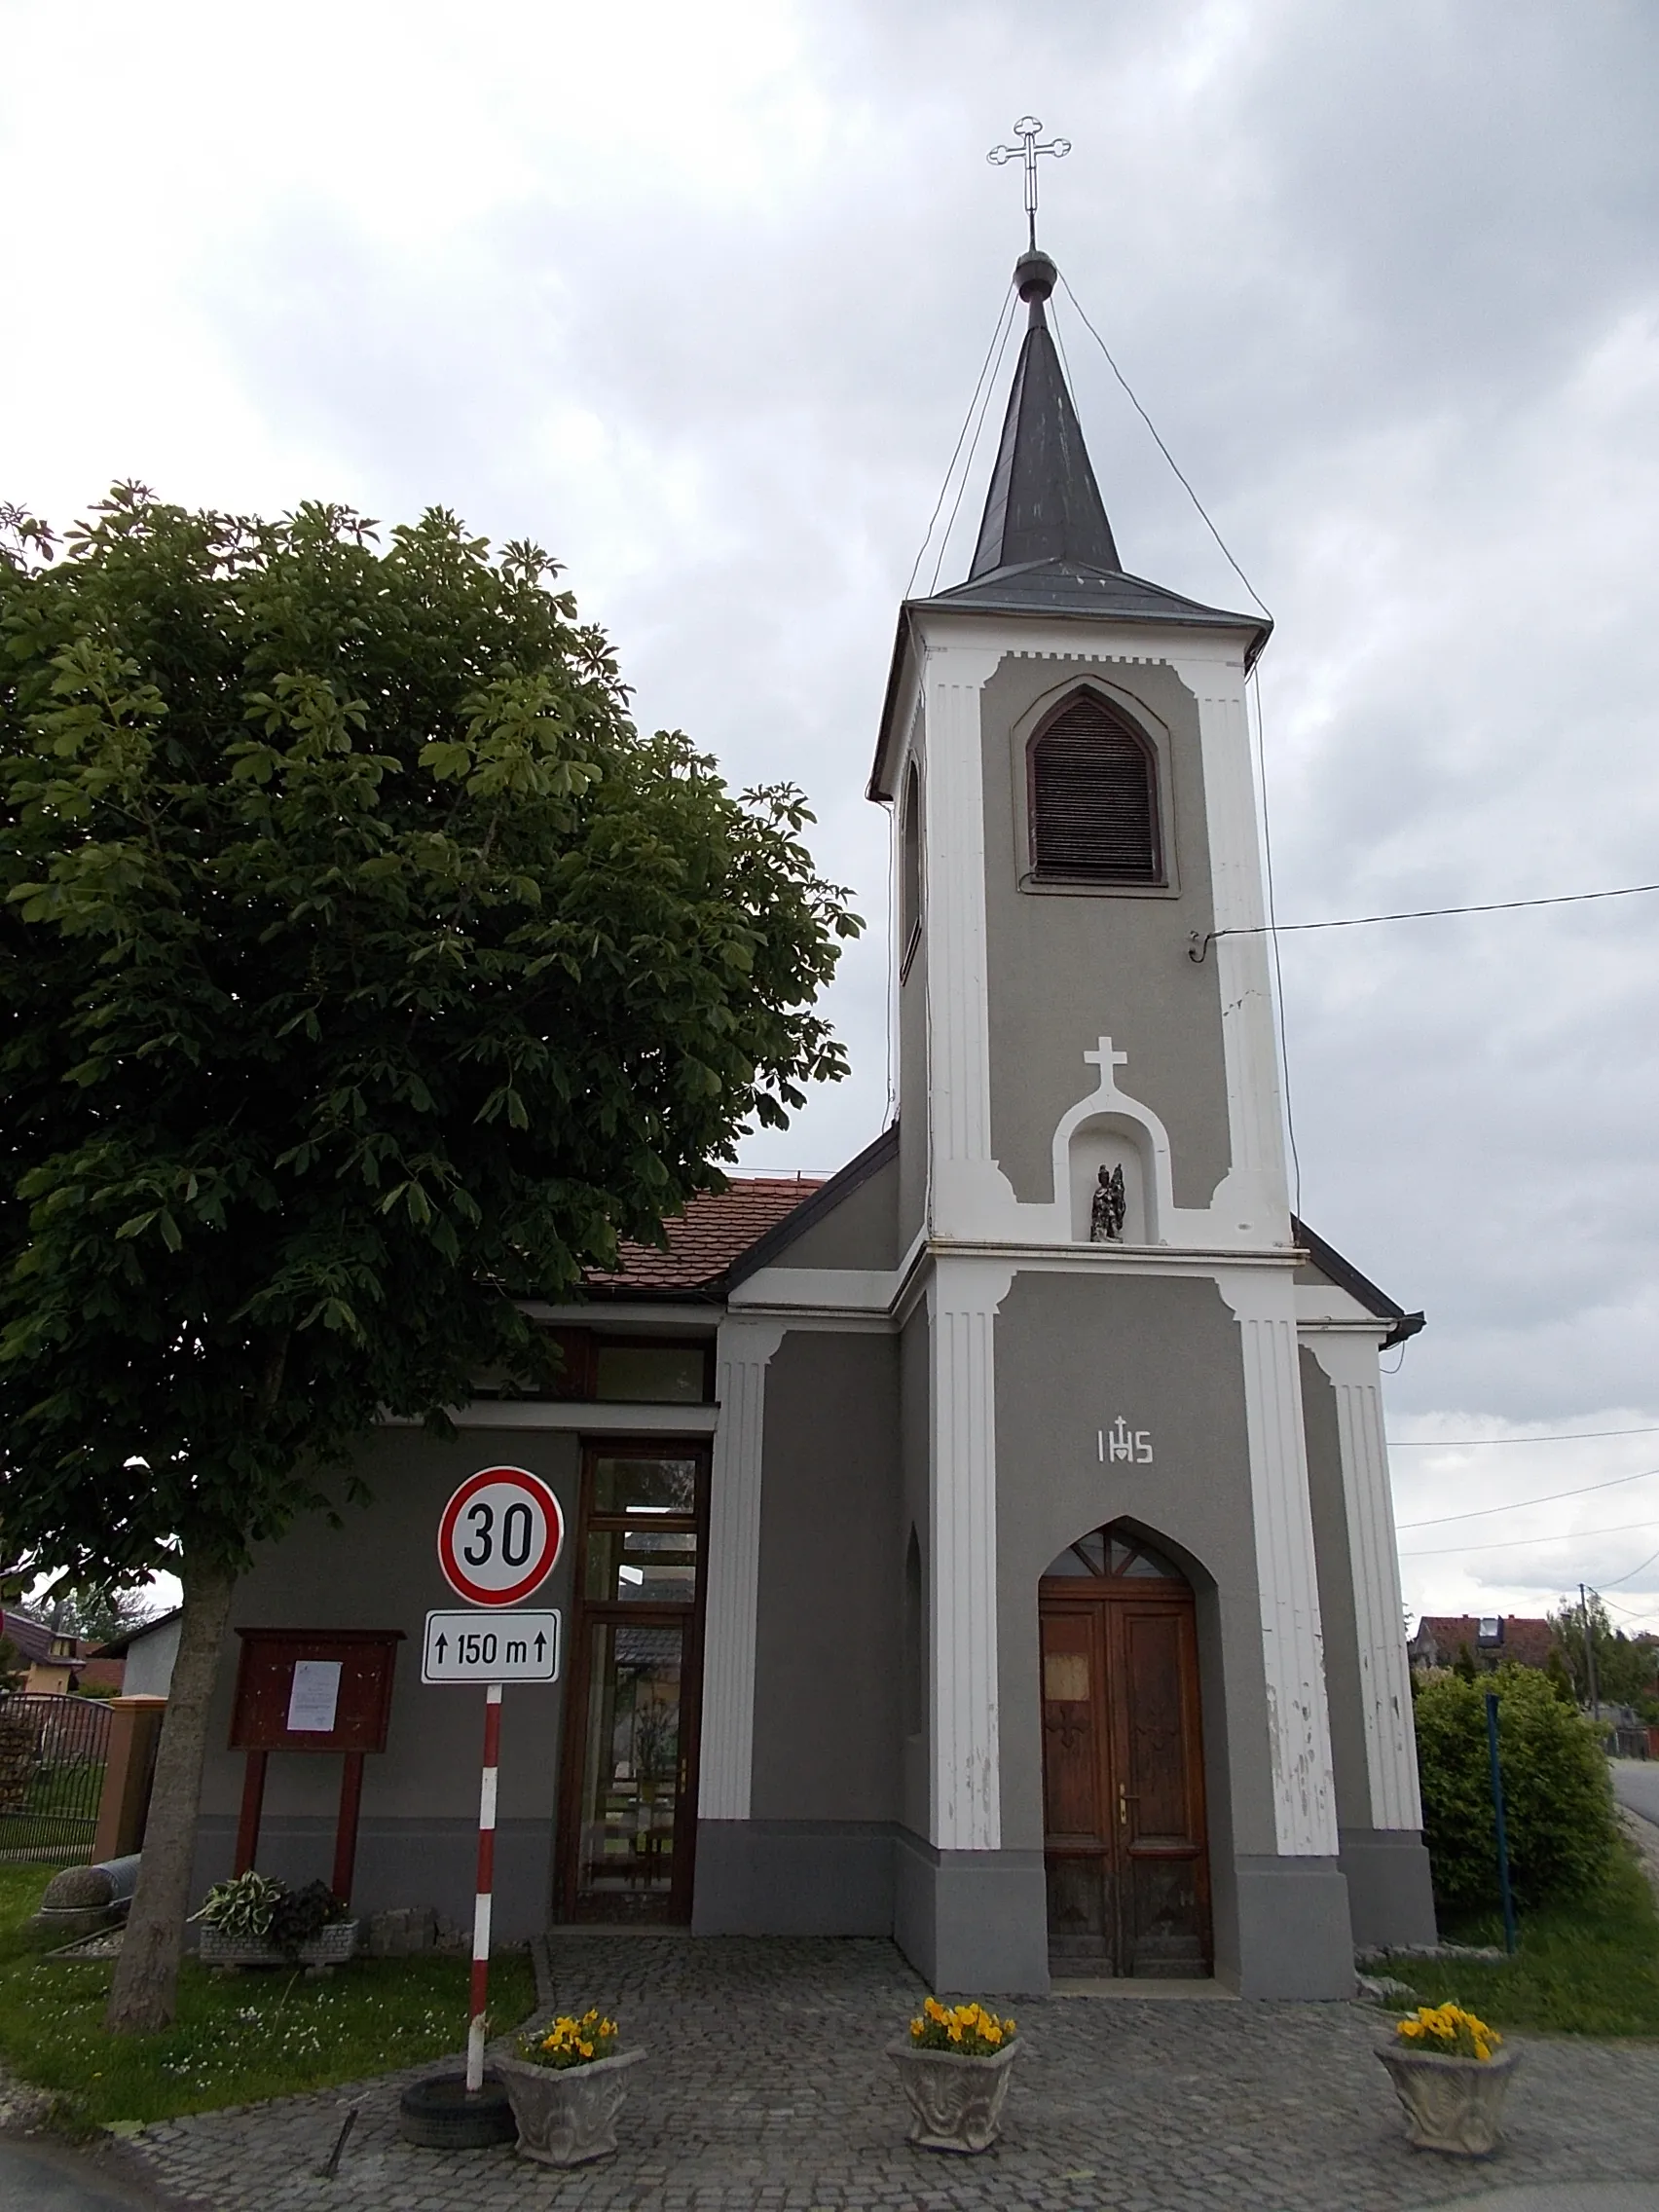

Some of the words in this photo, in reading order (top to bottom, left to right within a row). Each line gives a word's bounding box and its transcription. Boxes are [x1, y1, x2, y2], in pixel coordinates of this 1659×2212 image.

[1097, 1428, 1153, 1463] IHS
[463, 1502, 533, 1567] 30
[458, 1633, 498, 1665] 150
[505, 1640, 527, 1664] m
